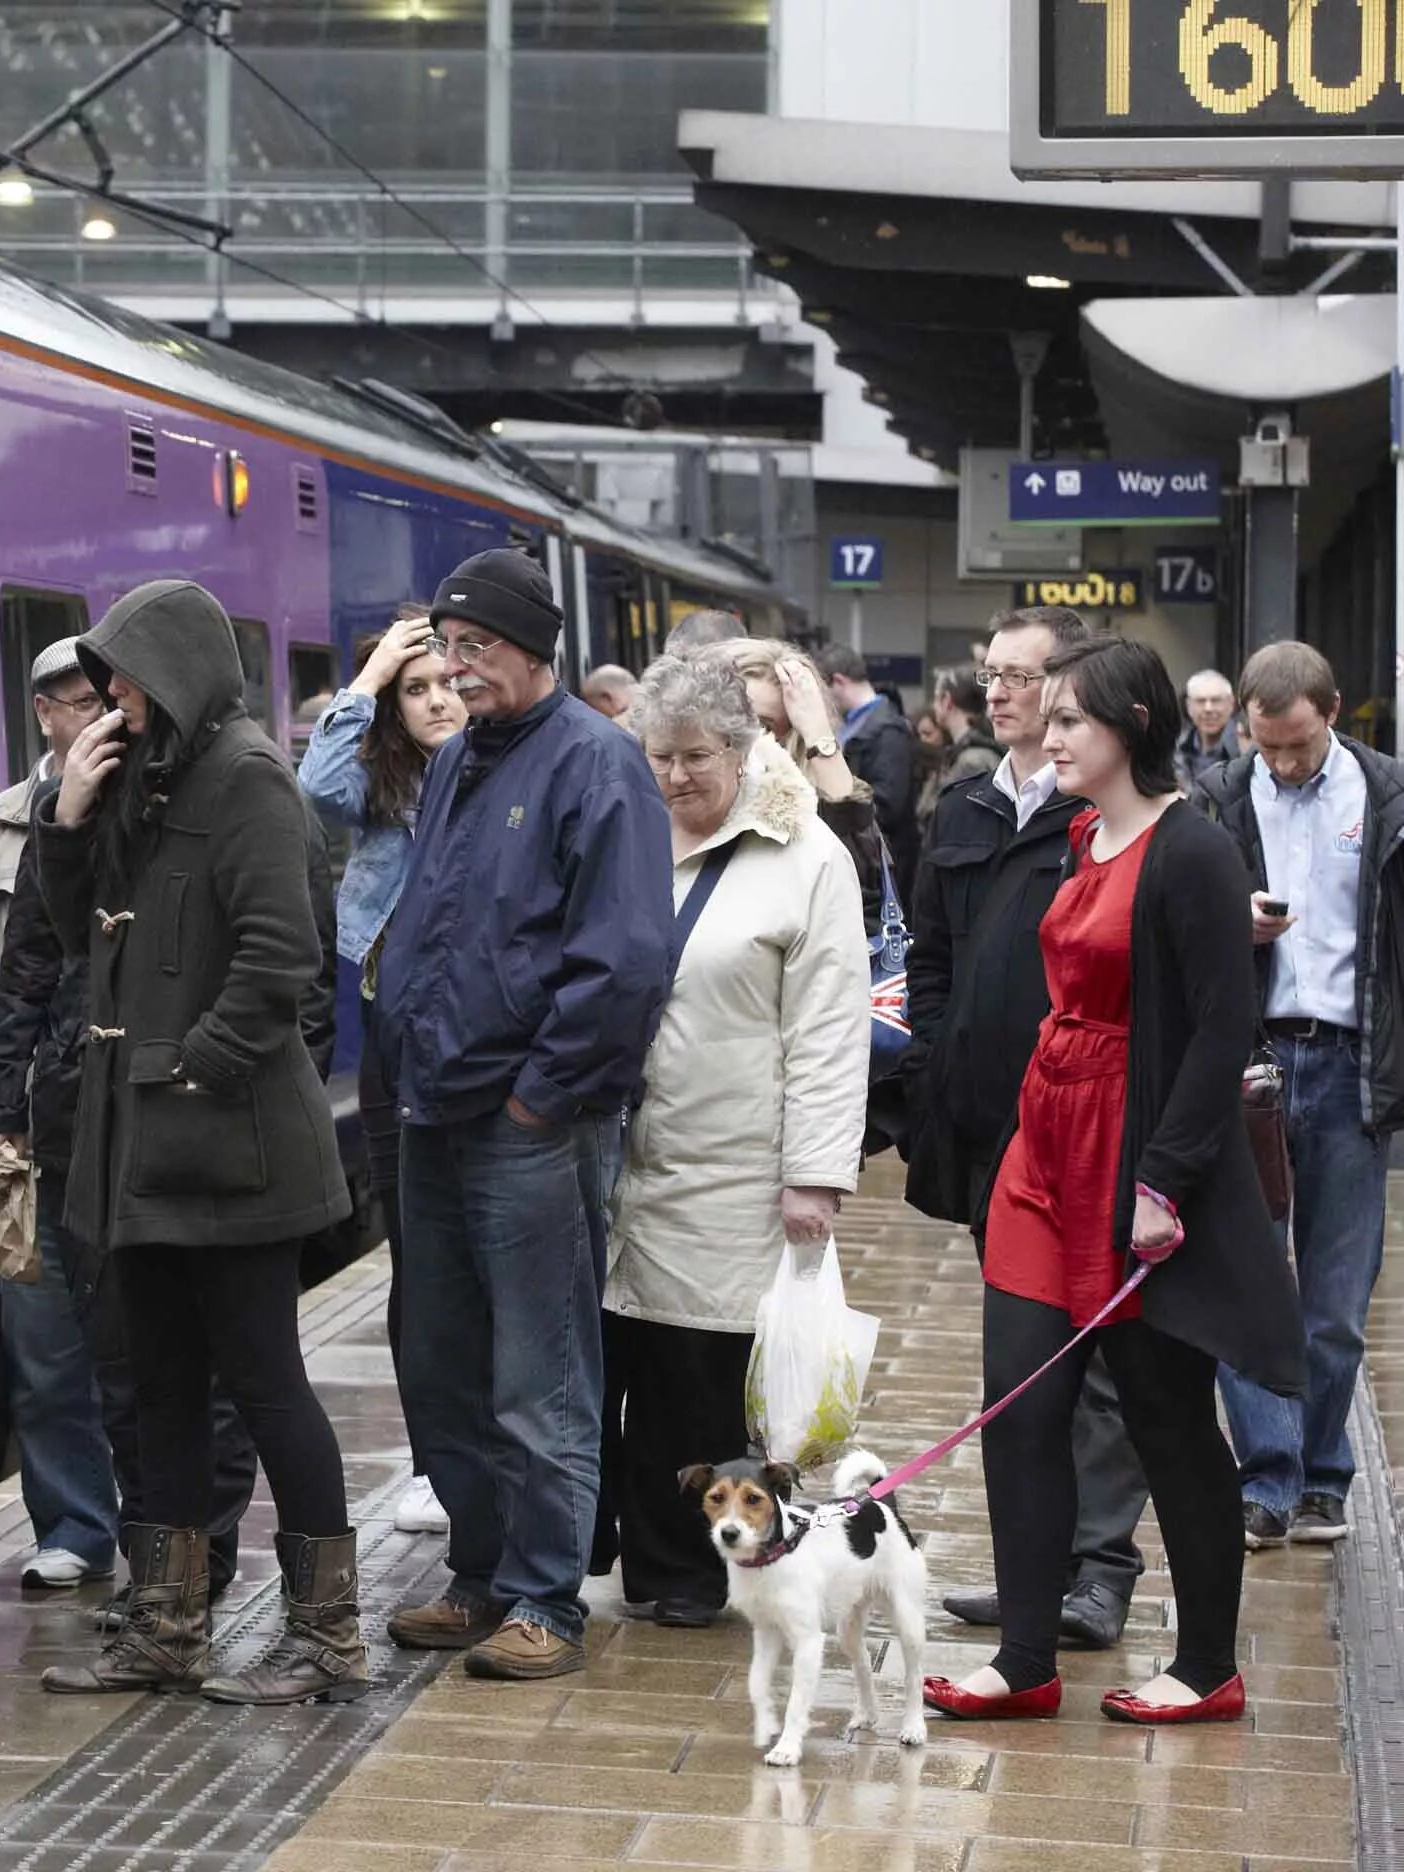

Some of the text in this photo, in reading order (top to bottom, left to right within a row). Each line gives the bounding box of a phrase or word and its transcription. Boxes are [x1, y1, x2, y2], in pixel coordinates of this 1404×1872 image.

[1077, 0, 1404, 114] 160
[1117, 469, 1208, 499] Way out
[840, 544, 875, 576] 17
[1157, 556, 1213, 593] 17b
